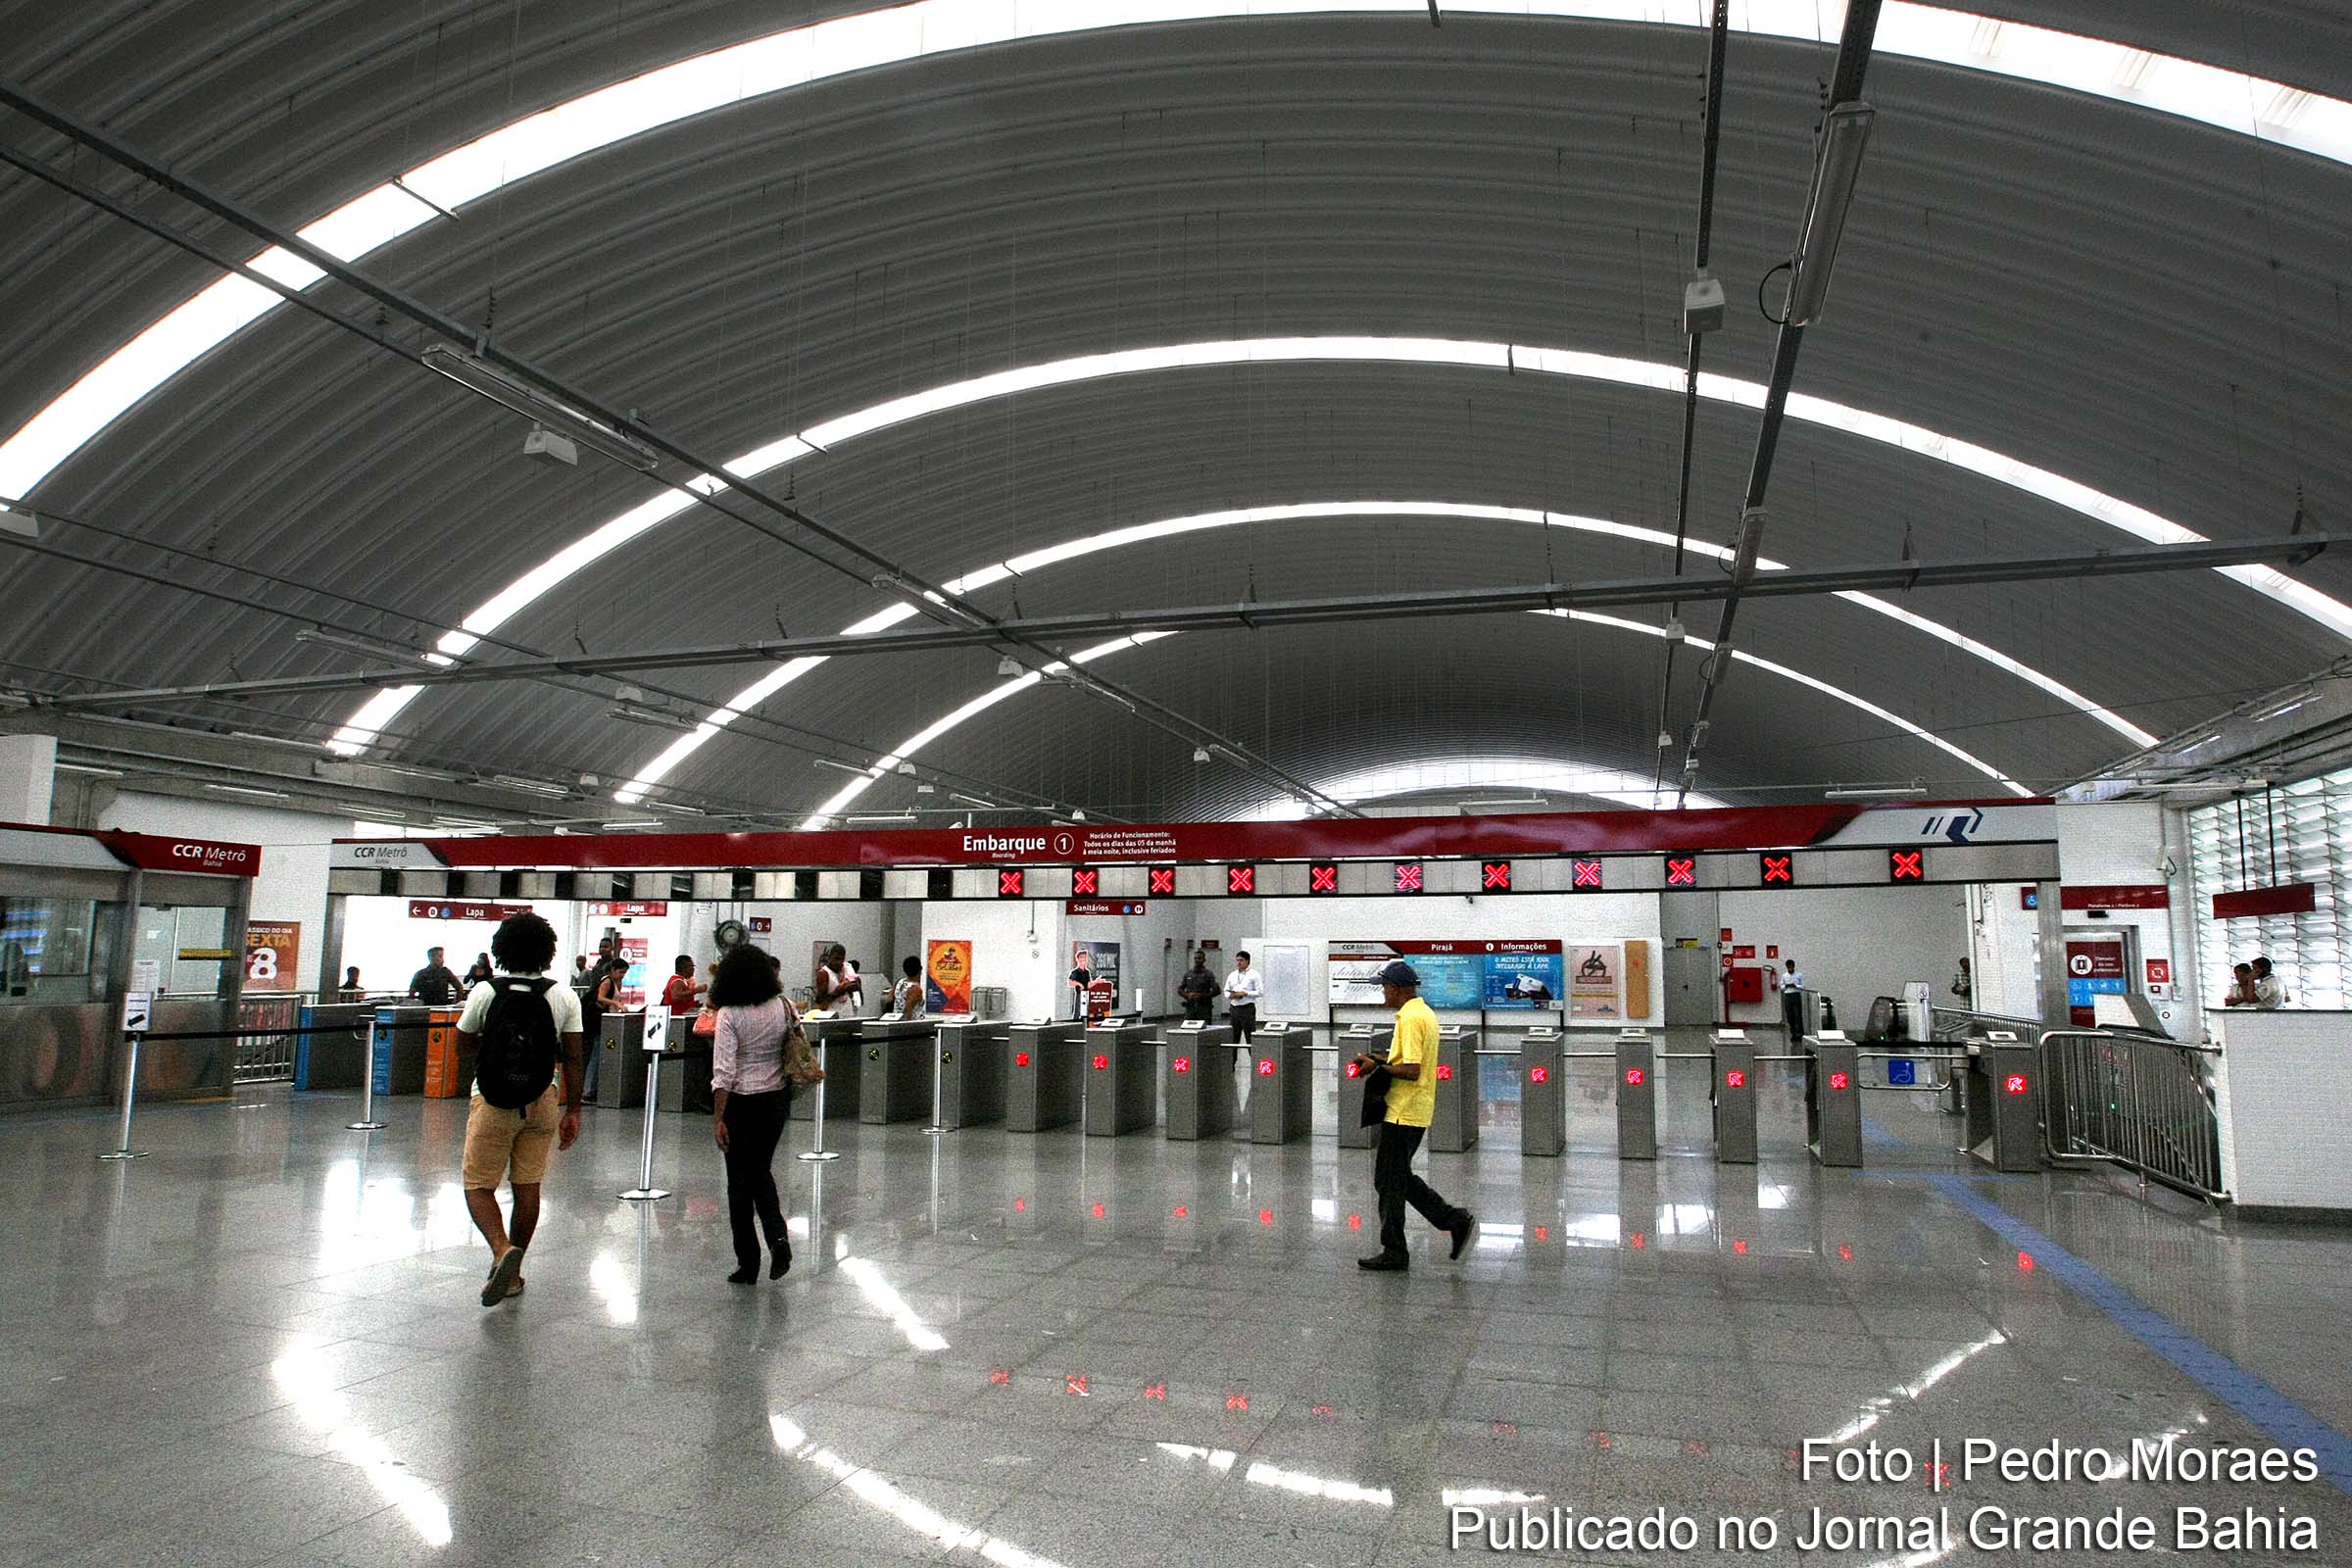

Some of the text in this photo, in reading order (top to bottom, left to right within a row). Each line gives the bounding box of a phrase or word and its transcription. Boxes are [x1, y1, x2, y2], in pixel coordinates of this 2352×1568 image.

[963, 834, 1067, 855] Embarque 1
[172, 844, 246, 861] CCR Metrô
[354, 846, 408, 858] CCR Metrô
[466, 907, 484, 917] Lapa
[626, 904, 645, 914] Lapa
[1073, 904, 1109, 912] Sanitários
[1431, 943, 1453, 952] Pirajá
[1500, 942, 1547, 951] Informações
[250, 947, 277, 980] 8
